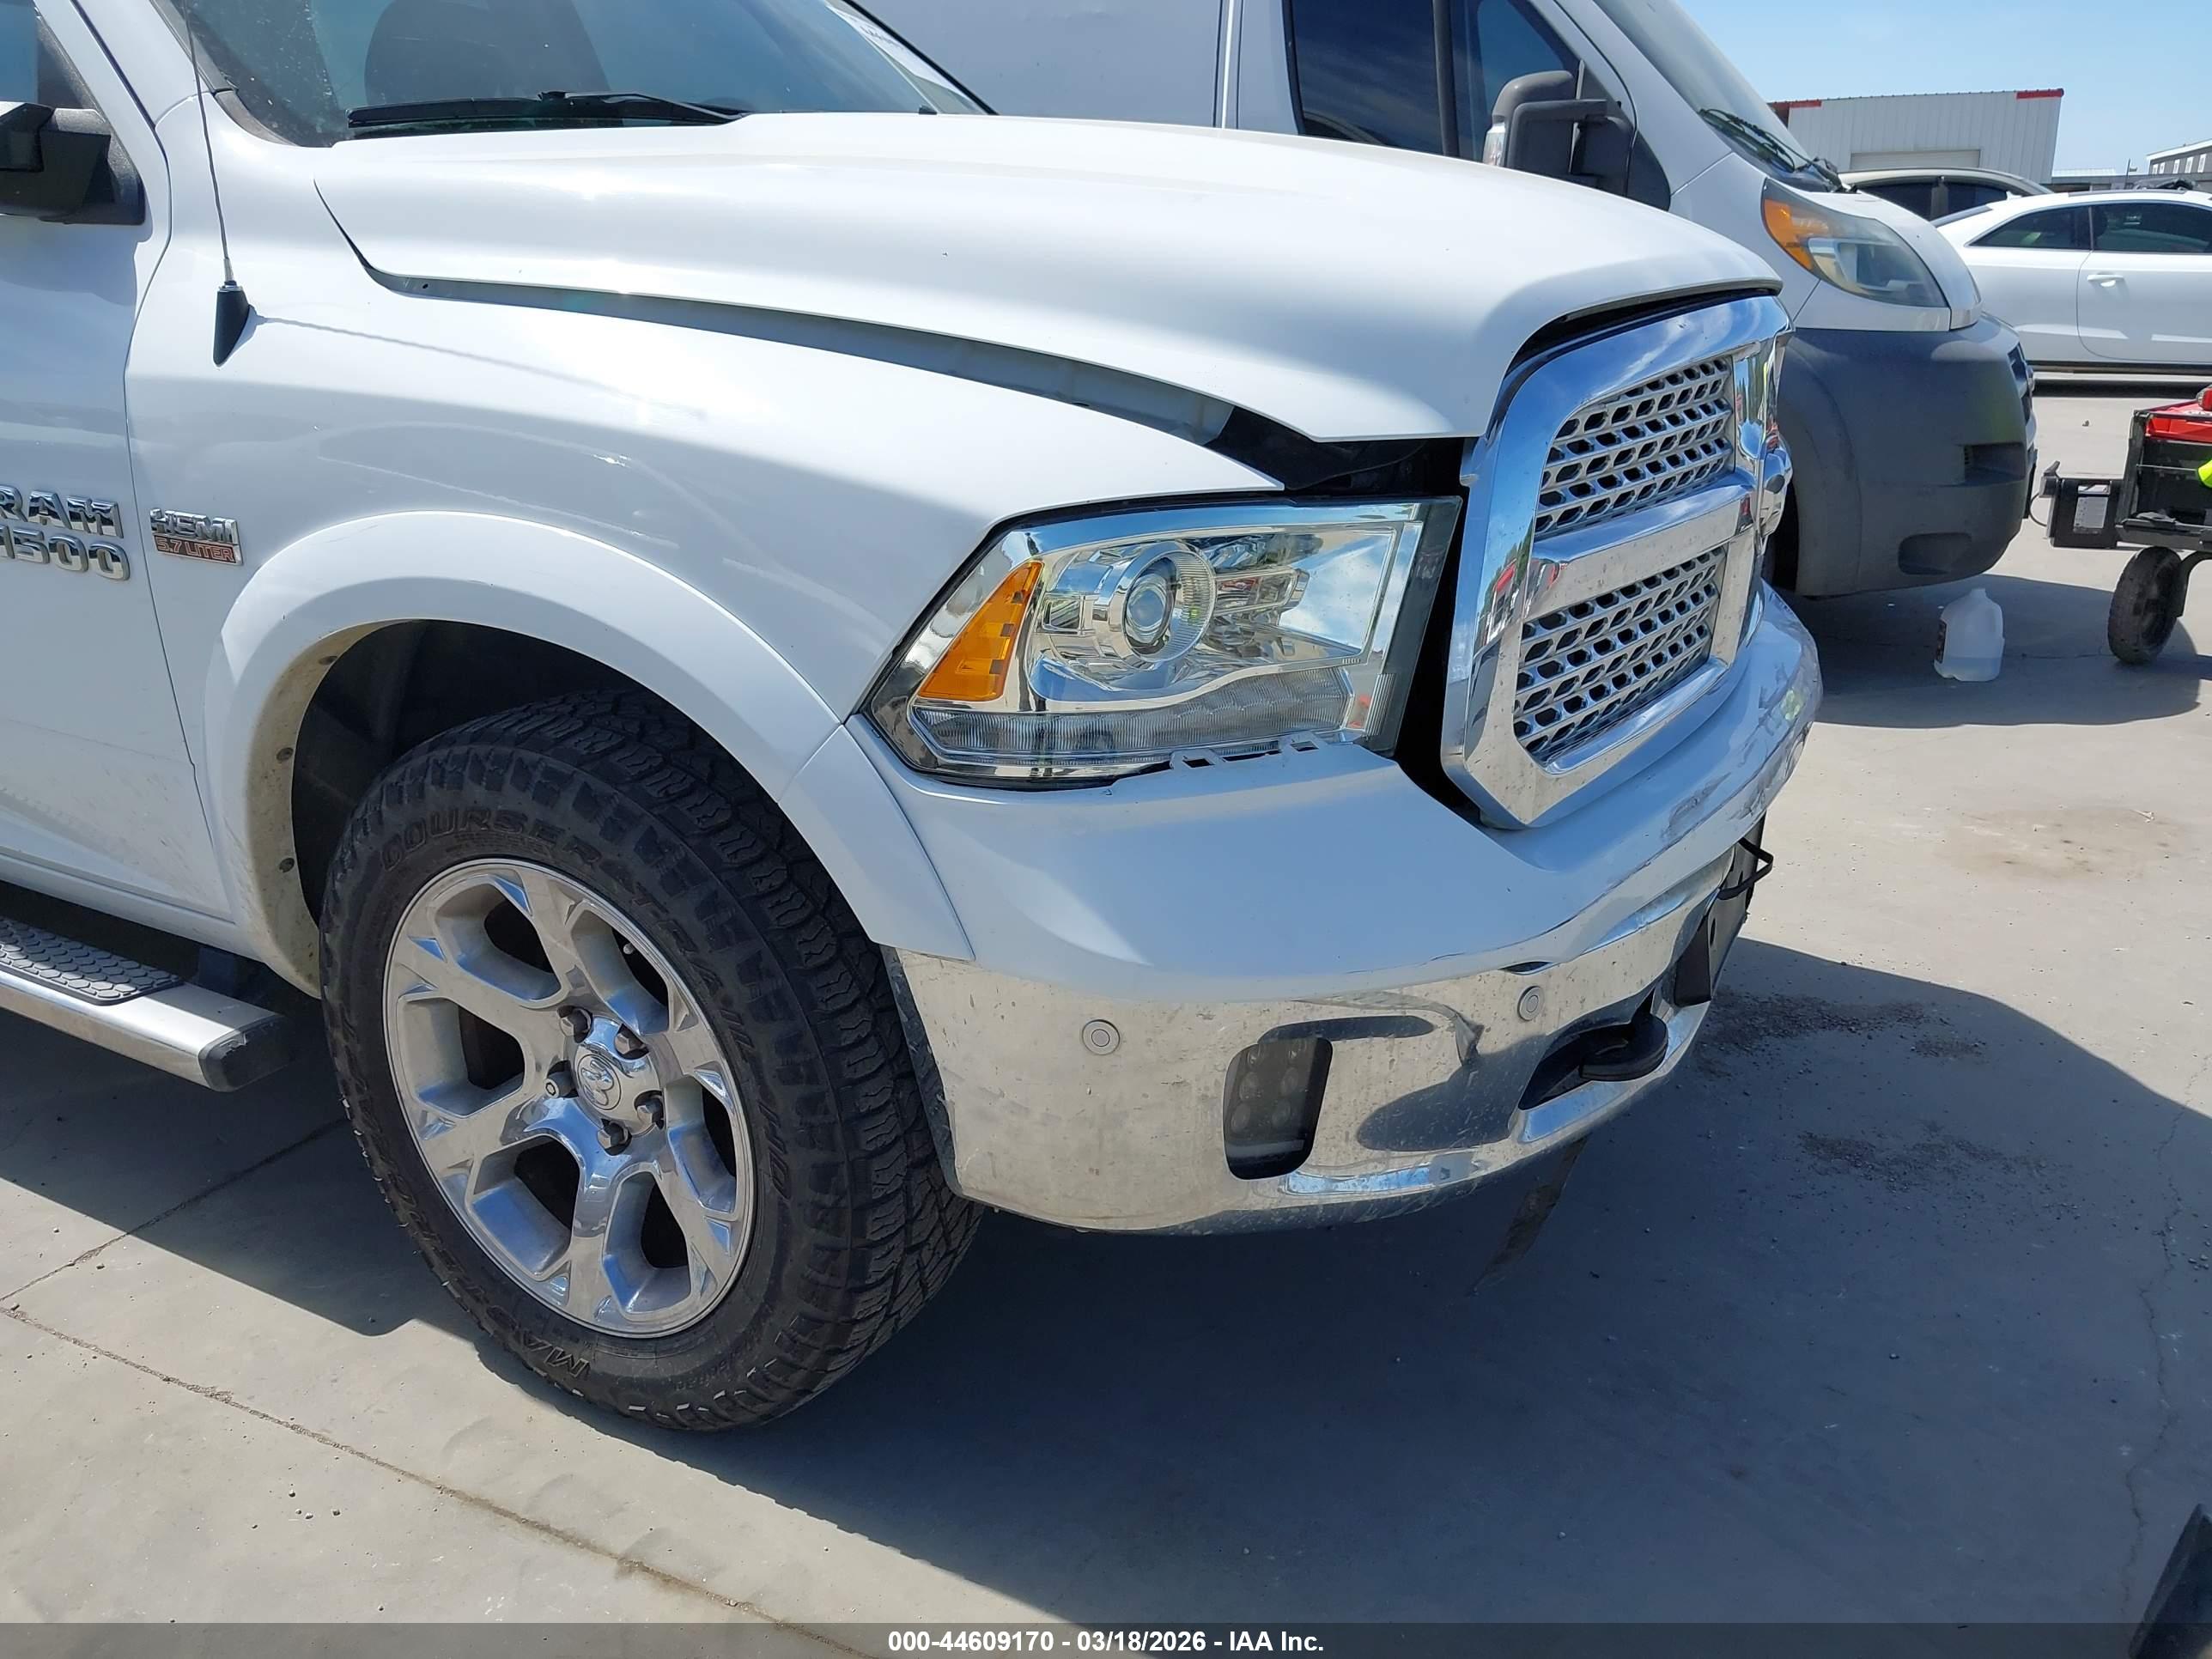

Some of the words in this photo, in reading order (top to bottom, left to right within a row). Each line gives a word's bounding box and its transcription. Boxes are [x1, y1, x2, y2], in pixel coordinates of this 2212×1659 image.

[0, 484, 125, 539] RAM
[149, 507, 241, 545] HEMI
[0, 524, 131, 581] 1500
[155, 536, 182, 554] 5.7
[184, 541, 234, 562] LITER
[380, 807, 603, 873] COURSER
